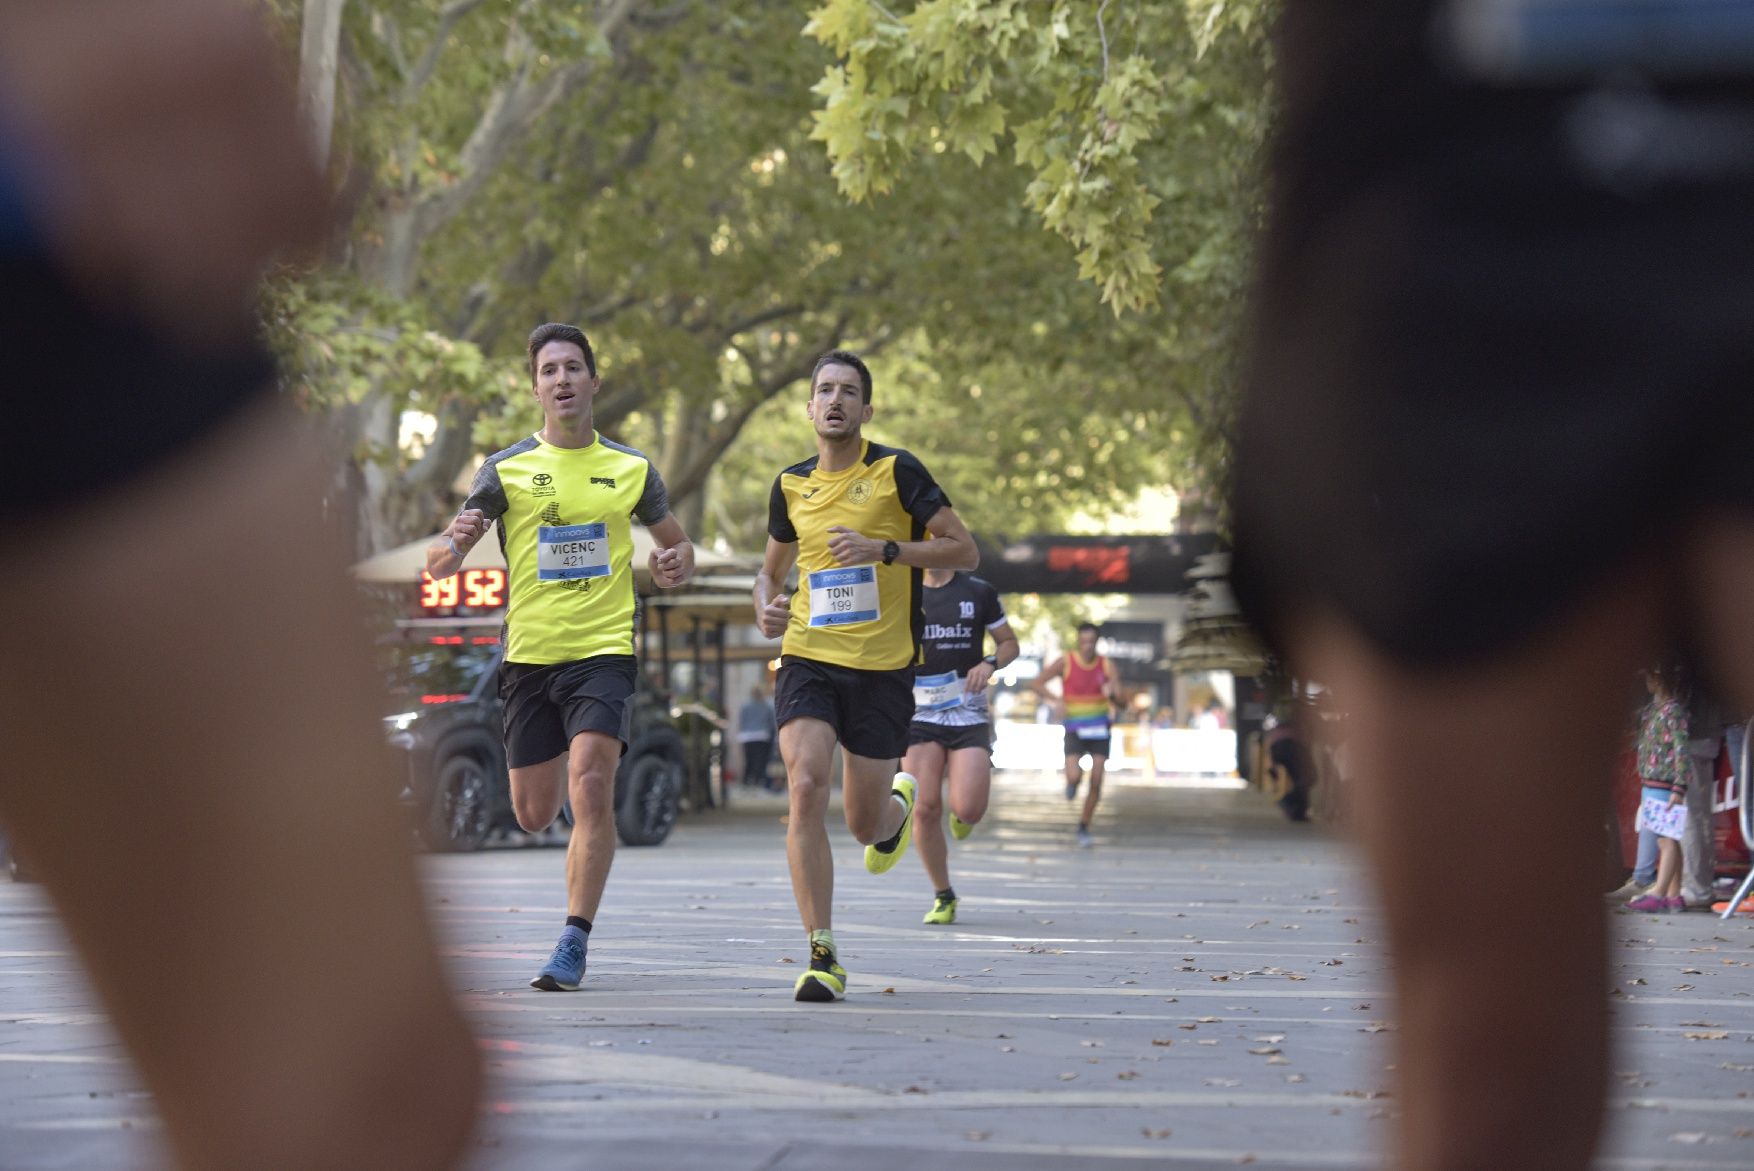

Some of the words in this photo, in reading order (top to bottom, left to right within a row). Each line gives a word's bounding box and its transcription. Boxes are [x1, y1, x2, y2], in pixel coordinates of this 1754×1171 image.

[551, 541, 595, 555] VICENÇ
[563, 555, 584, 567] 421
[421, 570, 458, 607] 39
[465, 568, 505, 607] 52
[827, 587, 854, 599] TONI
[831, 599, 852, 611] 199
[960, 601, 975, 615] 10
